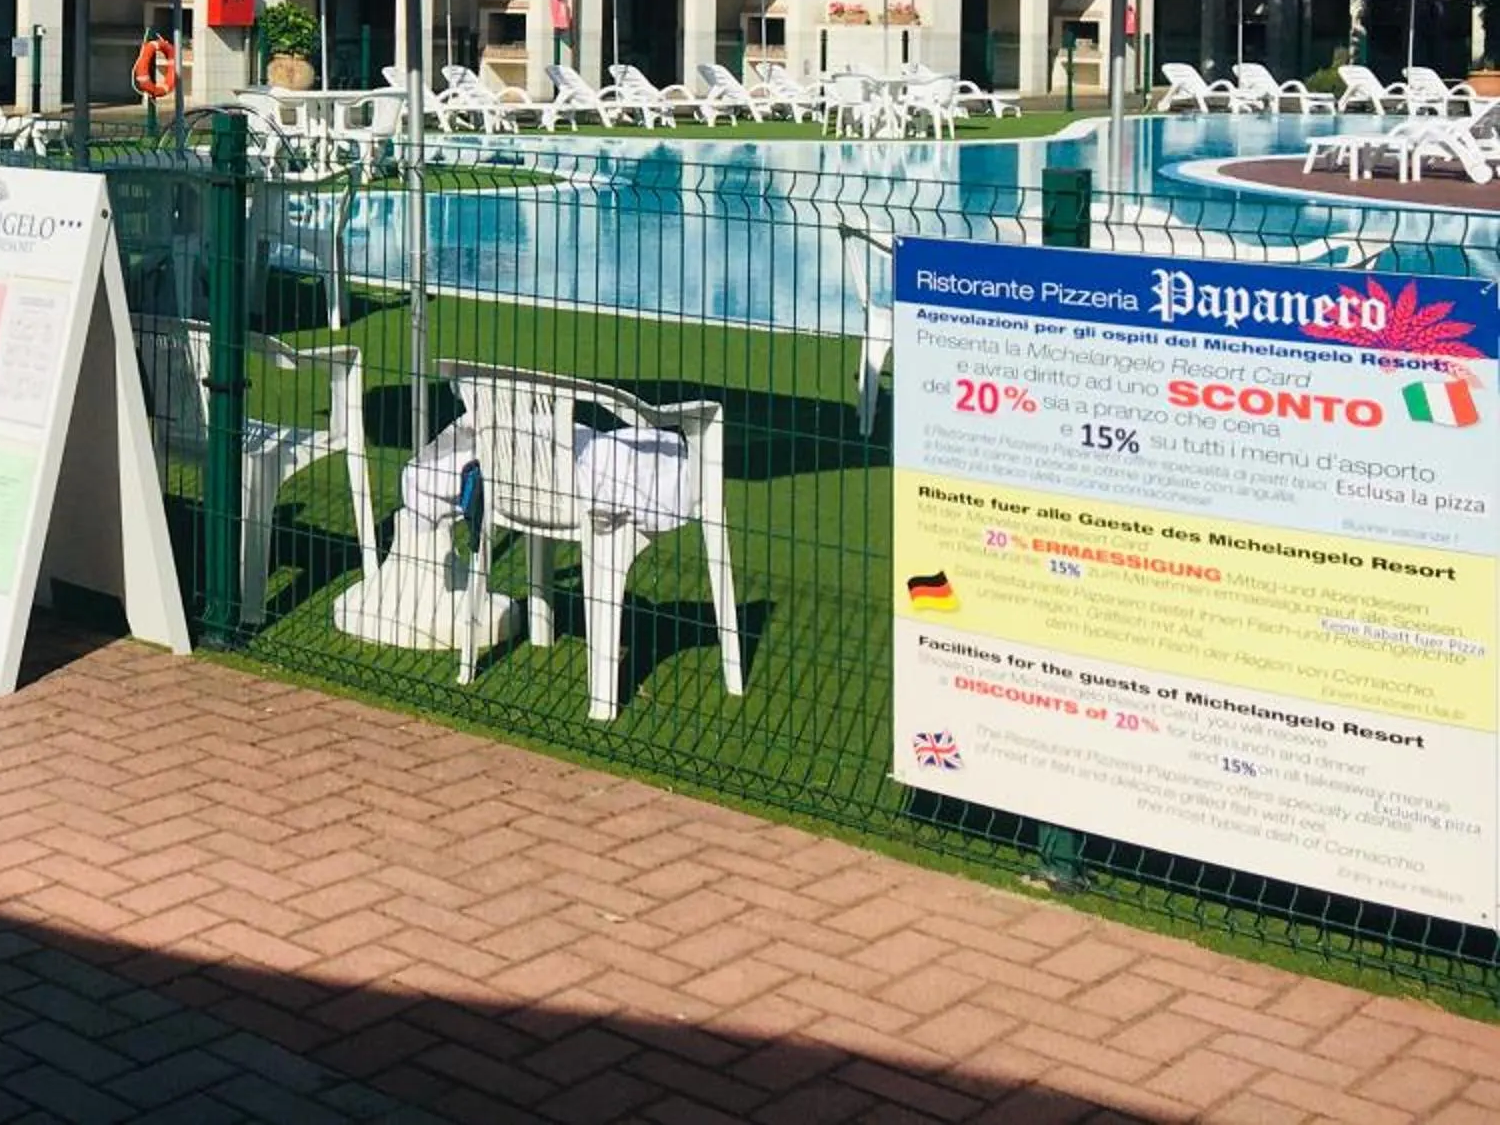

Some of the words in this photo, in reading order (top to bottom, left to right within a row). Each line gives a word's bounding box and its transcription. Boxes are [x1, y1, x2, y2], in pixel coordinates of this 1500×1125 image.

[916, 268, 1034, 301] Ristorante
[1041, 281, 1138, 311] Pizzeria
[1148, 268, 1386, 341] Papanero
[916, 308, 1028, 332] Agevolazioni
[1034, 321, 1063, 336] per
[1073, 323, 1095, 339] gli
[1101, 326, 1158, 345] ospiti
[1165, 334, 1196, 348] del
[1204, 337, 1352, 366] Michelangelo
[917, 328, 999, 355] Presenta
[1005, 338, 1020, 357] la
[1027, 341, 1164, 377] Michelangelo
[1171, 357, 1243, 382] Resort
[1251, 365, 1312, 388] Card
[955, 377, 1036, 420] 20%
[1043, 394, 1069, 412] sia
[1075, 400, 1087, 415] a
[1093, 401, 1171, 428] pranzo
[1174, 409, 1215, 430] che
[1223, 416, 1280, 438] cena
[957, 360, 967, 373] e
[973, 361, 1017, 379] avrai
[1023, 364, 1079, 387] diritto
[1084, 372, 1111, 391] ad
[1117, 379, 1158, 398] uno
[1167, 378, 1382, 429] SCONTO
[1060, 423, 1072, 437] e
[1080, 421, 1139, 455] 15%
[1150, 434, 1176, 451] su
[1183, 436, 1223, 457] tutti
[1316, 451, 1435, 487] d'asporto
[1336, 479, 1405, 503] Esclusa
[1410, 488, 1427, 506] la
[1435, 493, 1485, 516] pizza
[918, 485, 984, 509] Ribatte
[990, 497, 1030, 516] fuer
[1037, 505, 1071, 523] alle
[1078, 511, 1153, 536] Gaeste
[1161, 524, 1201, 543] des
[1208, 531, 1363, 571] Michelangelo
[1371, 555, 1455, 582] Resort
[1032, 536, 1220, 583] ERMAESSIGUNG
[1110, 533, 1150, 552] Card
[1050, 558, 1080, 577] 15%
[918, 634, 1001, 663] Facilities
[1007, 653, 1035, 671] for
[1041, 660, 1072, 678] the
[1079, 668, 1150, 697] guests
[1157, 684, 1178, 701] of
[1185, 690, 1335, 735] Michelangelo
[1343, 720, 1424, 751] Resort
[955, 675, 1078, 715] DISCOUNTS
[1085, 703, 1107, 721] of
[1222, 755, 1256, 778] 15%
